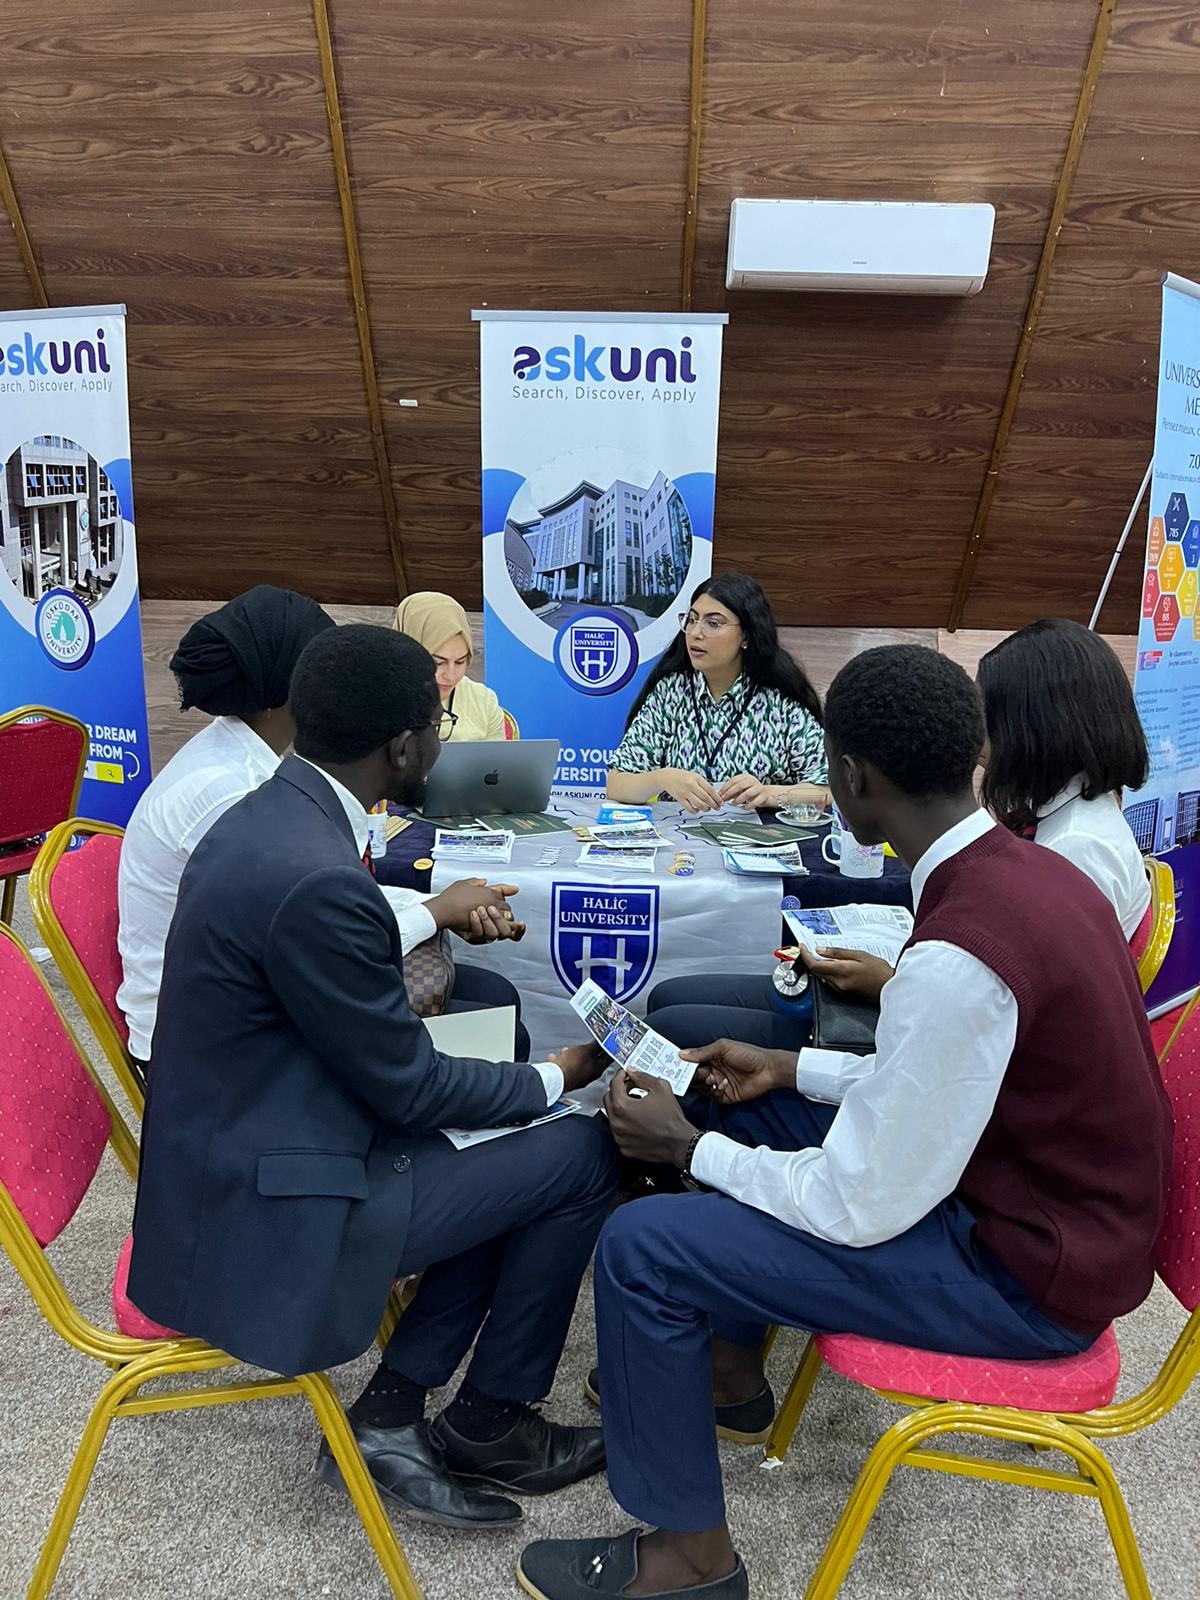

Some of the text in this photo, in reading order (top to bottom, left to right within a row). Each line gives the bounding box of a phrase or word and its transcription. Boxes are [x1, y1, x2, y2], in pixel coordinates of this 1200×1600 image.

[0, 328, 111, 376] skuni
[513, 334, 697, 383] askuni
[0, 379, 112, 393] arch, Discover, Apply
[512, 386, 696, 403] Search, Discover, Apply
[46, 633, 82, 655] UNIVERSITY
[574, 639, 614, 647] UNIVERSITY
[95, 725, 137, 744] DREAM
[90, 743, 123, 760] FROM
[557, 748, 613, 764] TO YOU
[582, 896, 628, 912] HALİÇ
[561, 911, 649, 926] UNIVERSITY
